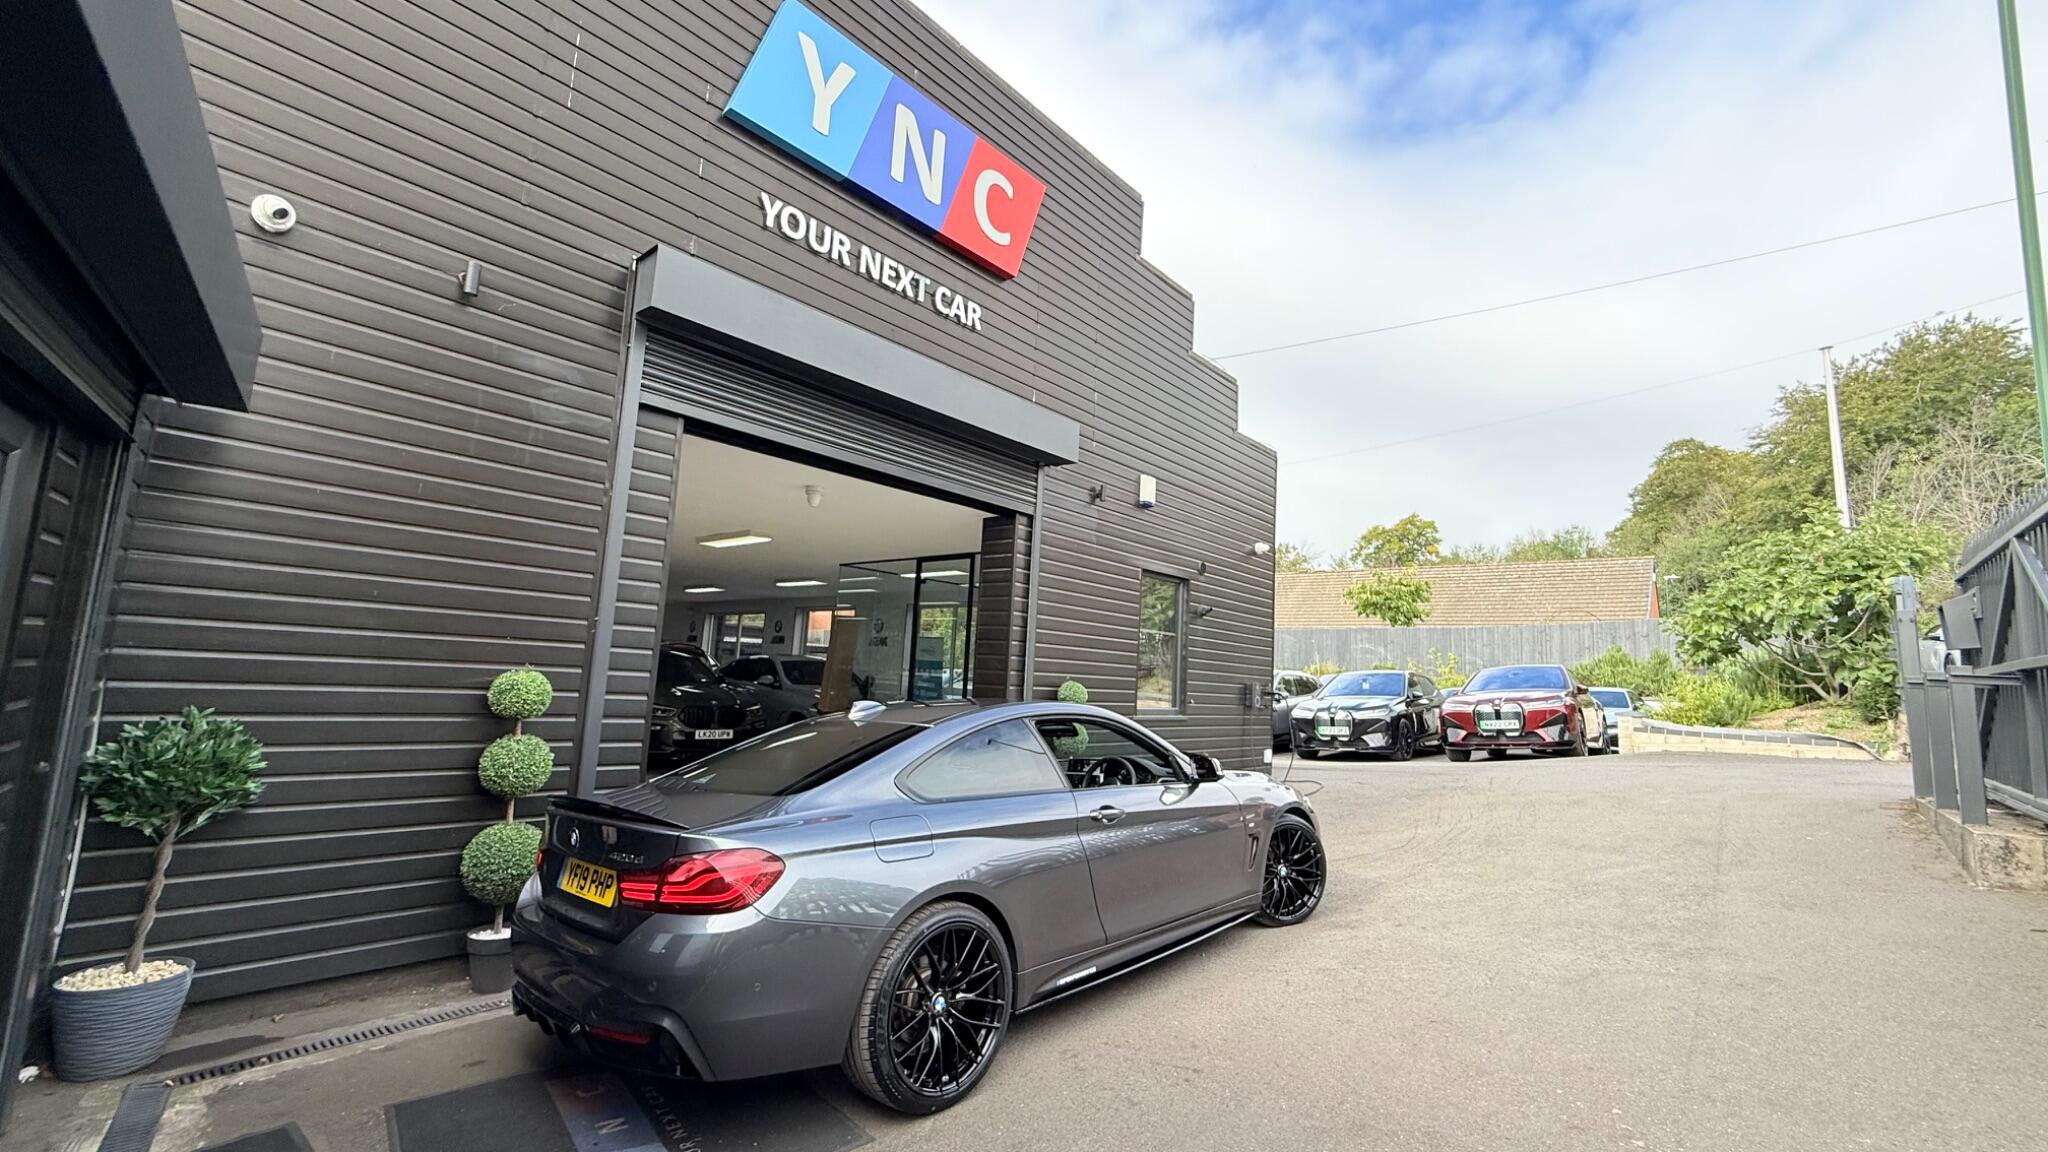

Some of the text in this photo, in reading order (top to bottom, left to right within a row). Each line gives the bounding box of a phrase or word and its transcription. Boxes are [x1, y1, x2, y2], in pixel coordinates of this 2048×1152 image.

[798, 31, 1014, 246] YNC
[760, 192, 982, 330] YOUR NEXT CAR
[567, 861, 614, 899] YF19 PHP
